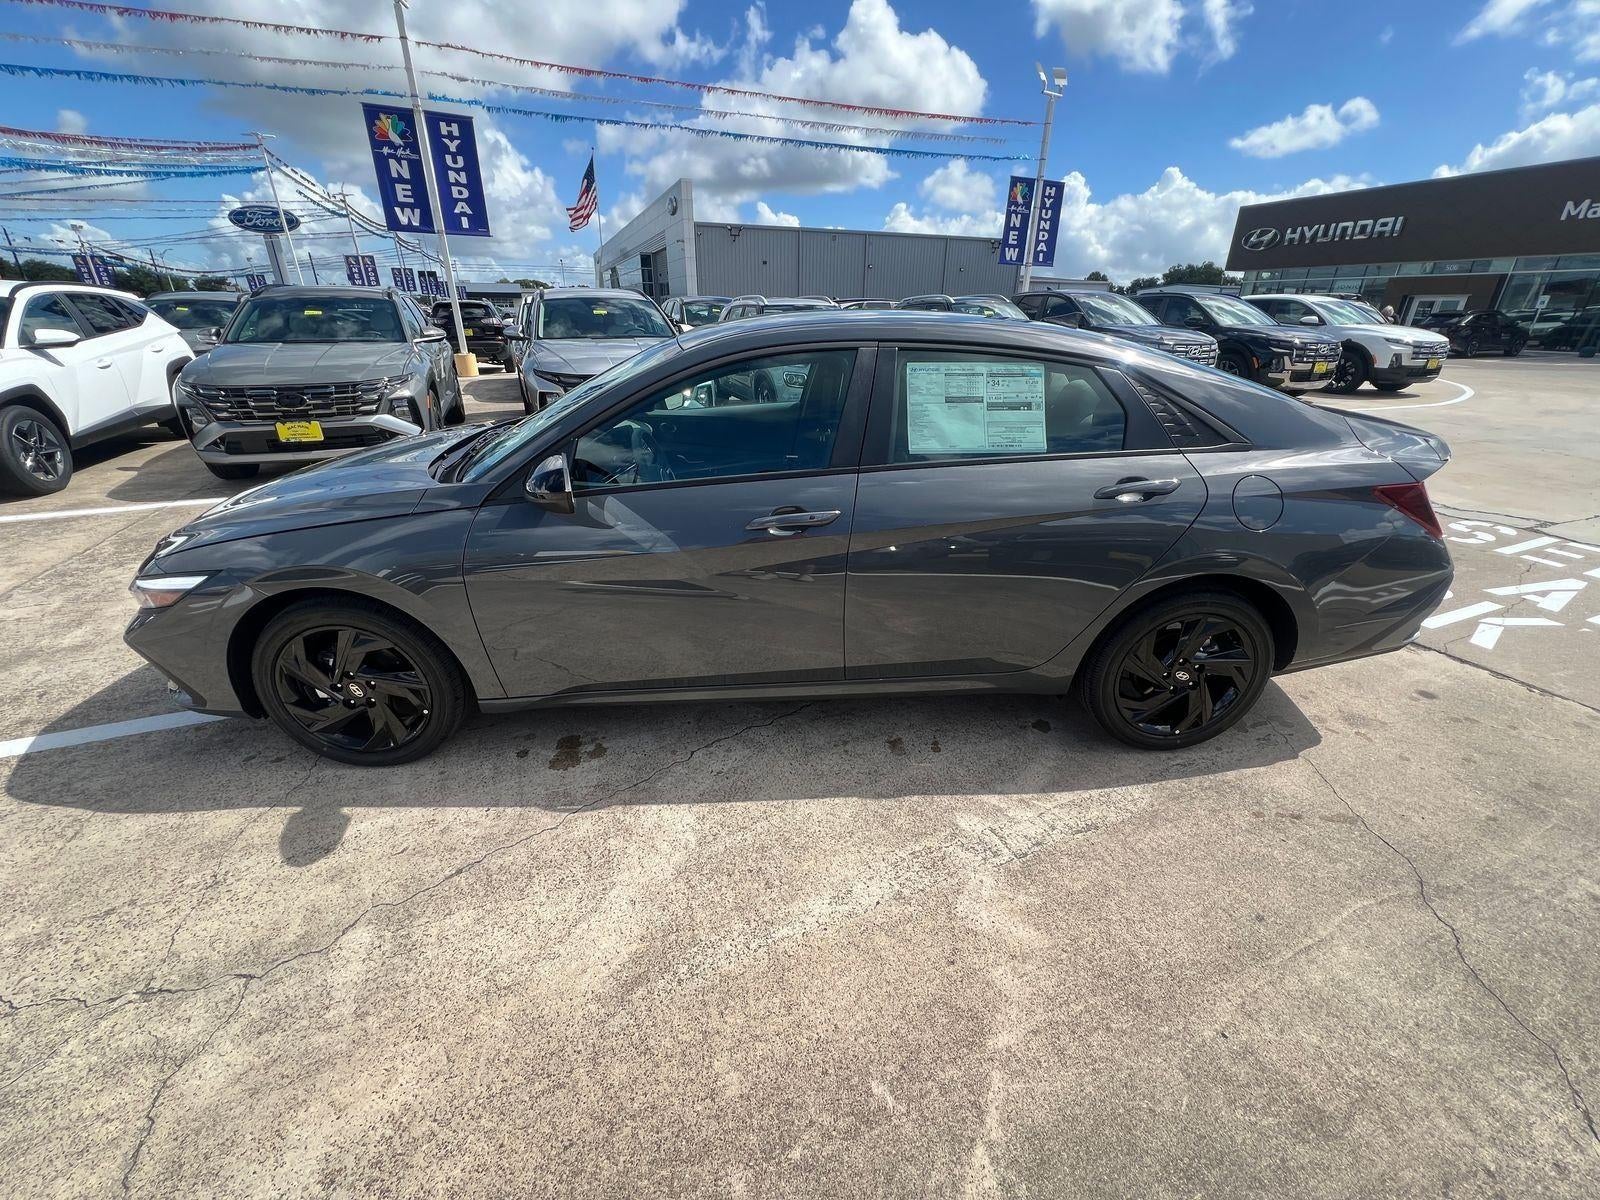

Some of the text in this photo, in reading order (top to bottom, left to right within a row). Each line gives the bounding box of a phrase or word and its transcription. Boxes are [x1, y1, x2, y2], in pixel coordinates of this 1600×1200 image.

[389, 158, 420, 226] NEW
[440, 121, 472, 228] HYUNDAI
[1005, 213, 1021, 261] NEW
[1037, 186, 1056, 262] HYUNDAI
[1284, 216, 1404, 246] HYUNDAI
